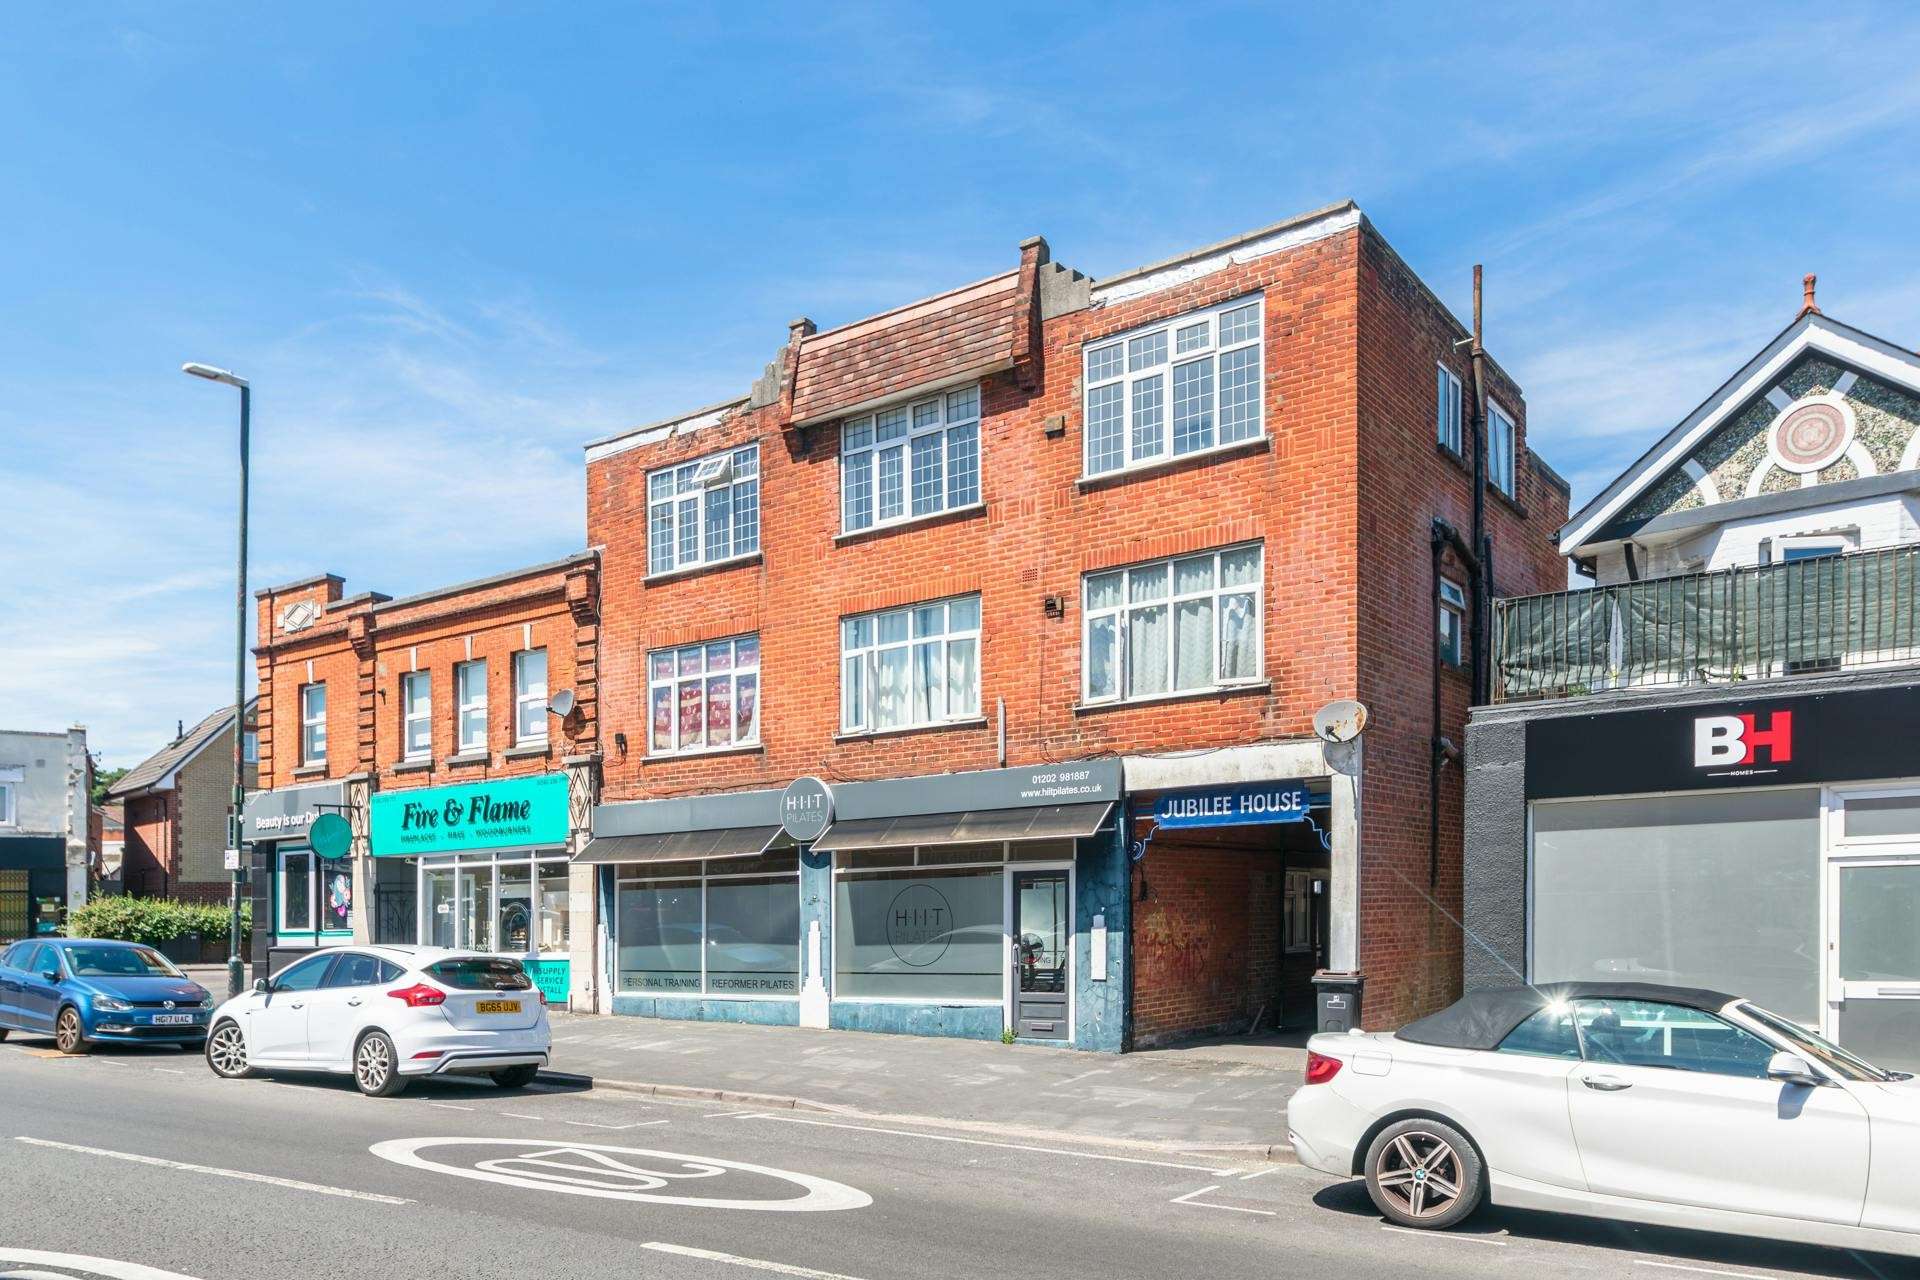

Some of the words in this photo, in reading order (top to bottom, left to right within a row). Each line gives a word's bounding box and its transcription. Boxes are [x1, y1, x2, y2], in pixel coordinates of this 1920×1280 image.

[1694, 711, 1792, 767] BH
[1032, 773, 1057, 784] 01202
[1059, 771, 1090, 782] 981887
[1020, 784, 1102, 797] www.hiitpilates.co.uk
[1162, 796, 1232, 818] JUBILEE
[1240, 791, 1302, 814] HOUSE
[402, 802, 438, 830] Fire
[443, 798, 464, 826] &
[468, 794, 532, 824] Flame
[786, 811, 823, 823] PILATES
[256, 815, 282, 829] Beauty
[283, 814, 290, 826] is
[290, 815, 305, 826] our
[623, 977, 662, 988] PERSONAL
[663, 978, 701, 988] TRAINING
[711, 978, 758, 989] REFORMER
[760, 979, 795, 990] PILATES
